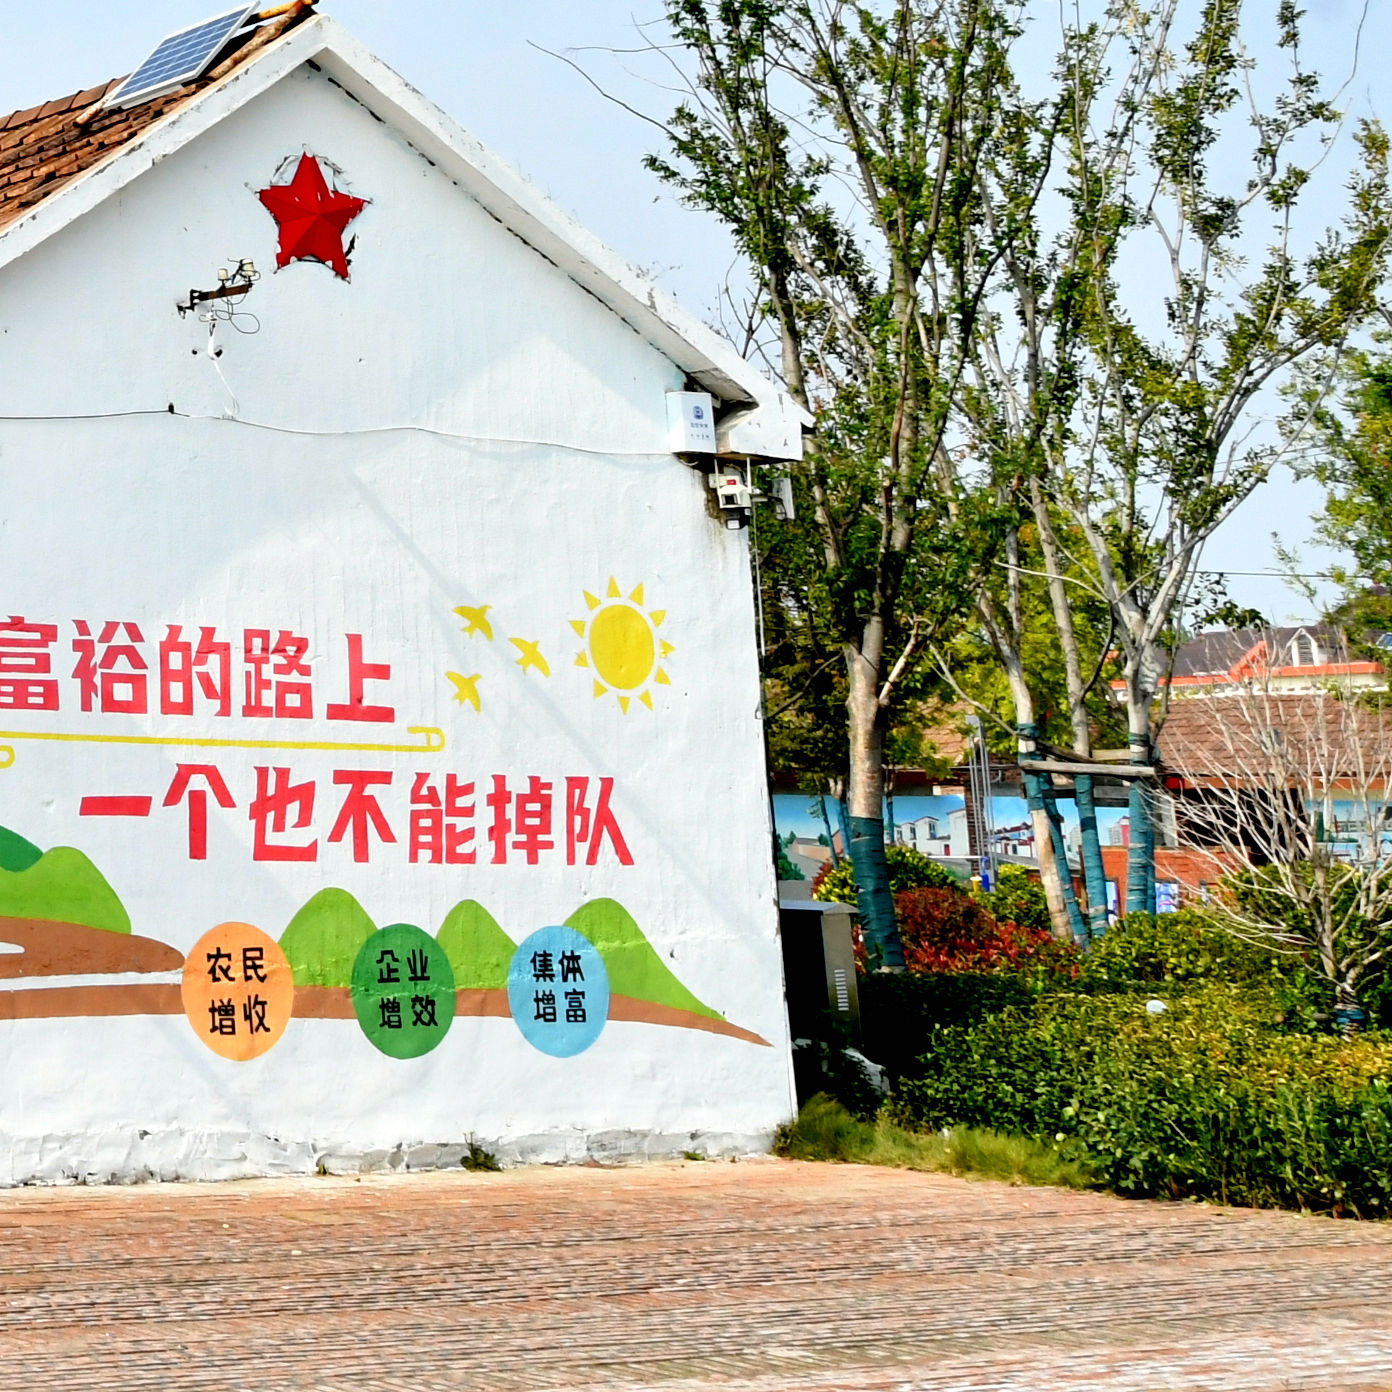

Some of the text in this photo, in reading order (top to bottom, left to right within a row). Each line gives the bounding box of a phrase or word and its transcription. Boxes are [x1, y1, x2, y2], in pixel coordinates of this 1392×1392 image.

[79, 763, 635, 866] 一个也不能掉队
[206, 946, 268, 983] 农民
[375, 949, 431, 984] 企业
[530, 950, 585, 983] 集体
[208, 995, 271, 1035] 增收
[378, 994, 439, 1029] 增效
[533, 988, 587, 1023] 增富
